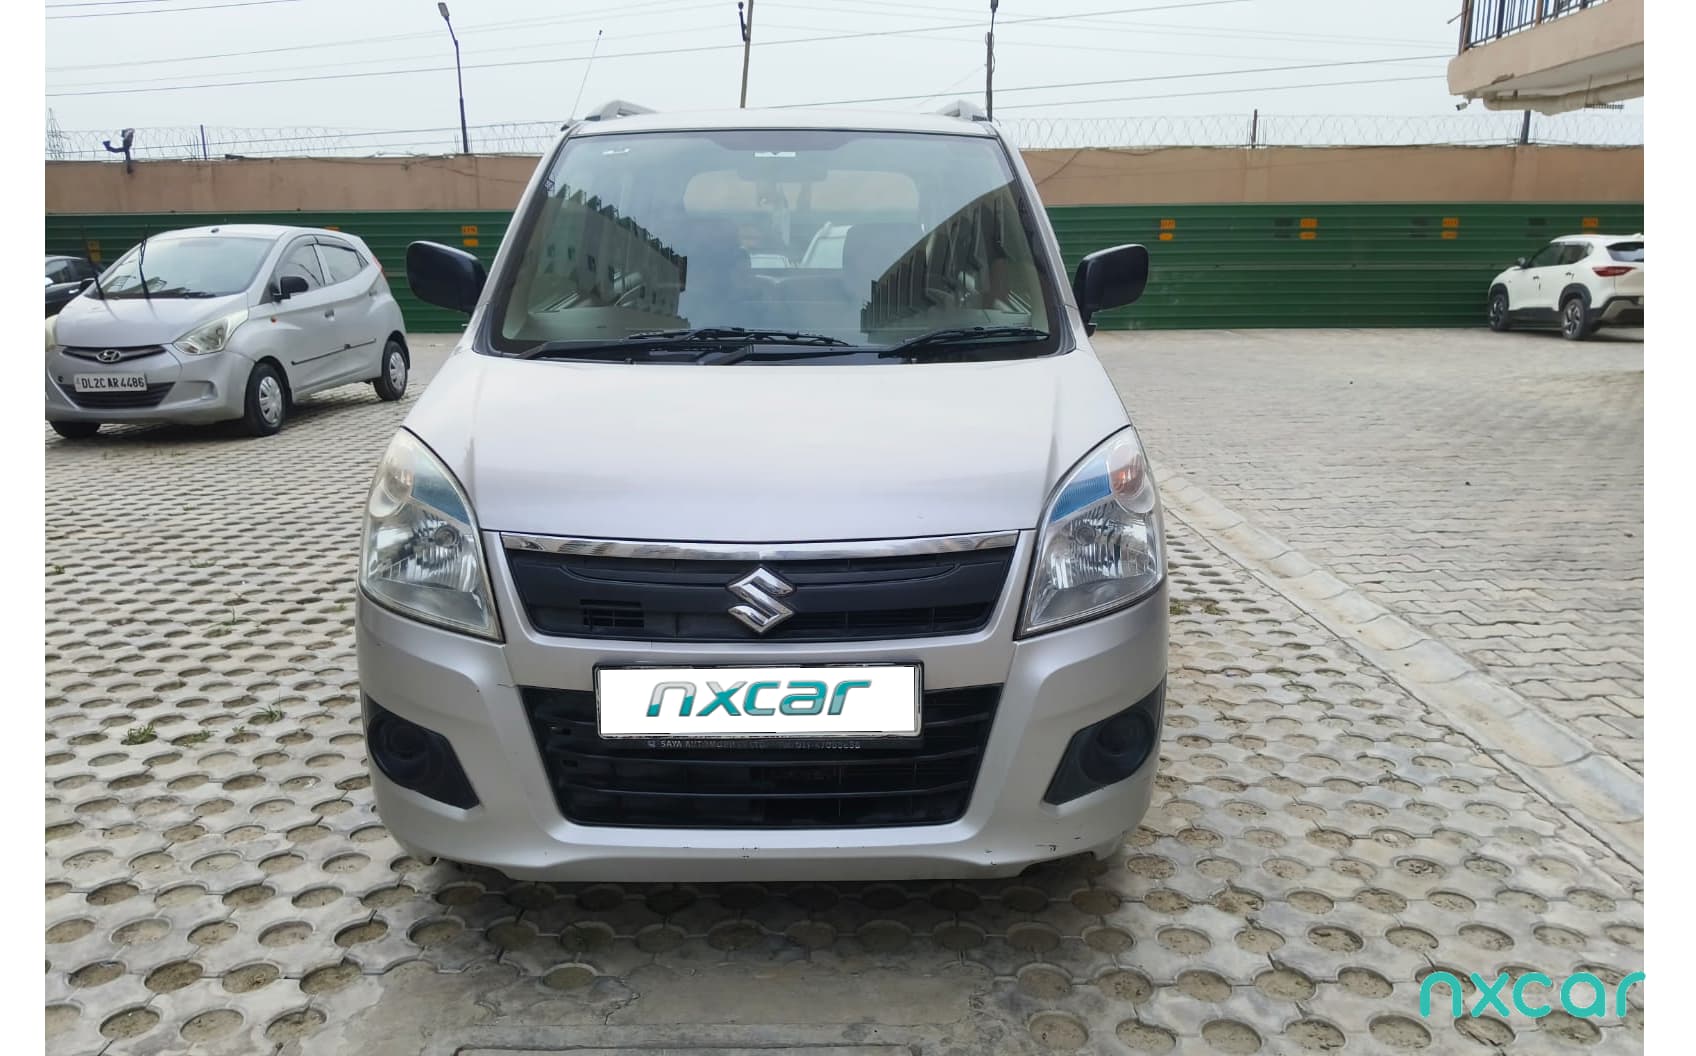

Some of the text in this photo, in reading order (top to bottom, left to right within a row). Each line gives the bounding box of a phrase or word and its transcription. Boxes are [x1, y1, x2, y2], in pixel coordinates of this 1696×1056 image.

[107, 377, 119, 388] AR
[120, 377, 145, 388] 4486
[660, 740, 681, 749] SAYA
